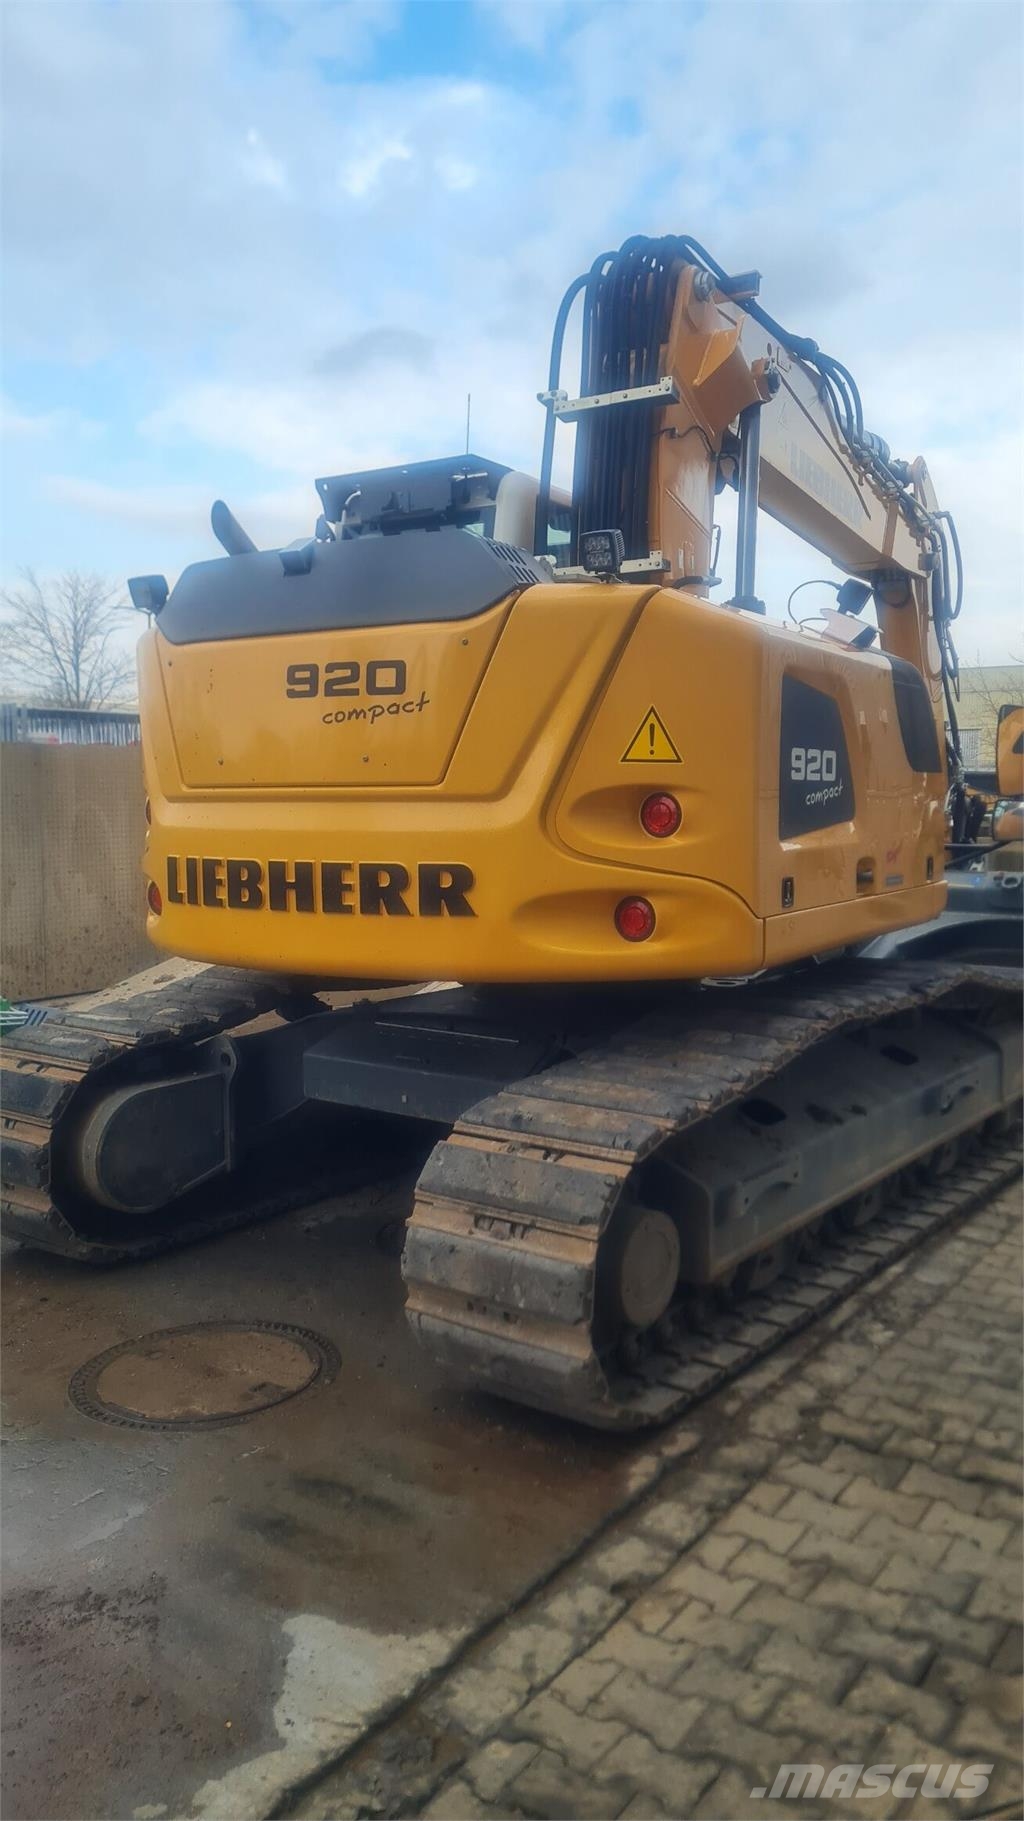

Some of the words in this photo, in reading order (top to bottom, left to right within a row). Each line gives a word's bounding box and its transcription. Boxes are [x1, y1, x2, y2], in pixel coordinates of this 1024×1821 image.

[286, 659, 407, 698] 920
[321, 691, 430, 725] compact
[791, 748, 836, 781] 920
[806, 780, 843, 806] compact
[166, 855, 478, 918] LIEBHERR
